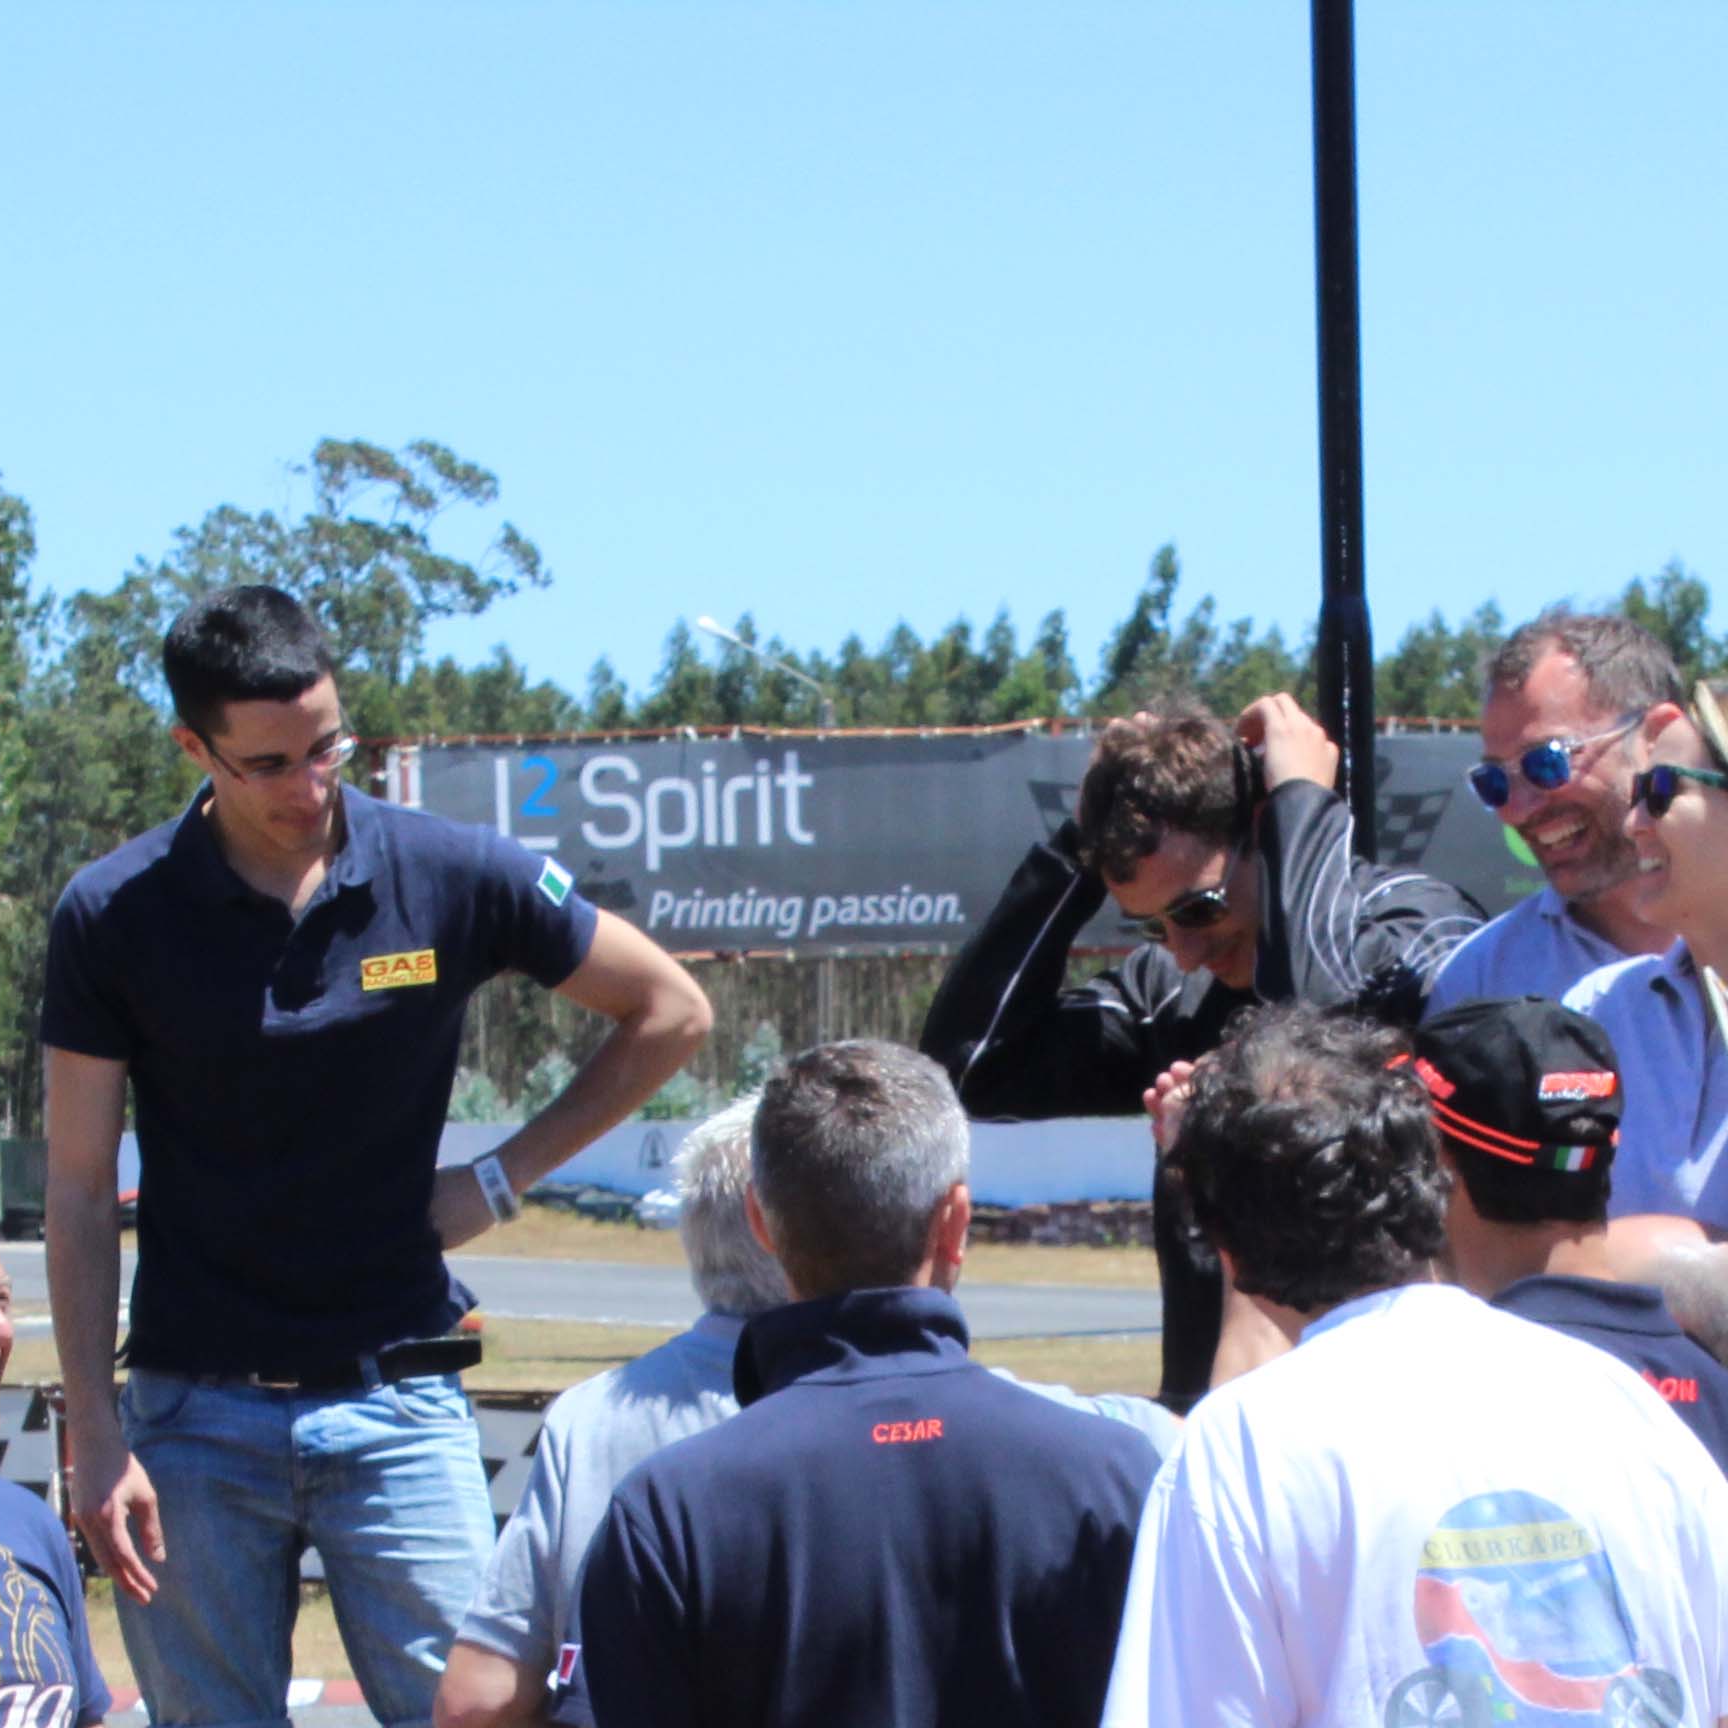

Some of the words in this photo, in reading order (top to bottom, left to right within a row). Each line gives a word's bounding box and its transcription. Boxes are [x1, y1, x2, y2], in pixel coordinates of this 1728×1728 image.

[579, 751, 815, 872] Spirit
[648, 887, 803, 939] Printing
[807, 884, 966, 936] passion.
[364, 954, 433, 976] GAS
[872, 1417, 944, 1444] CESAR
